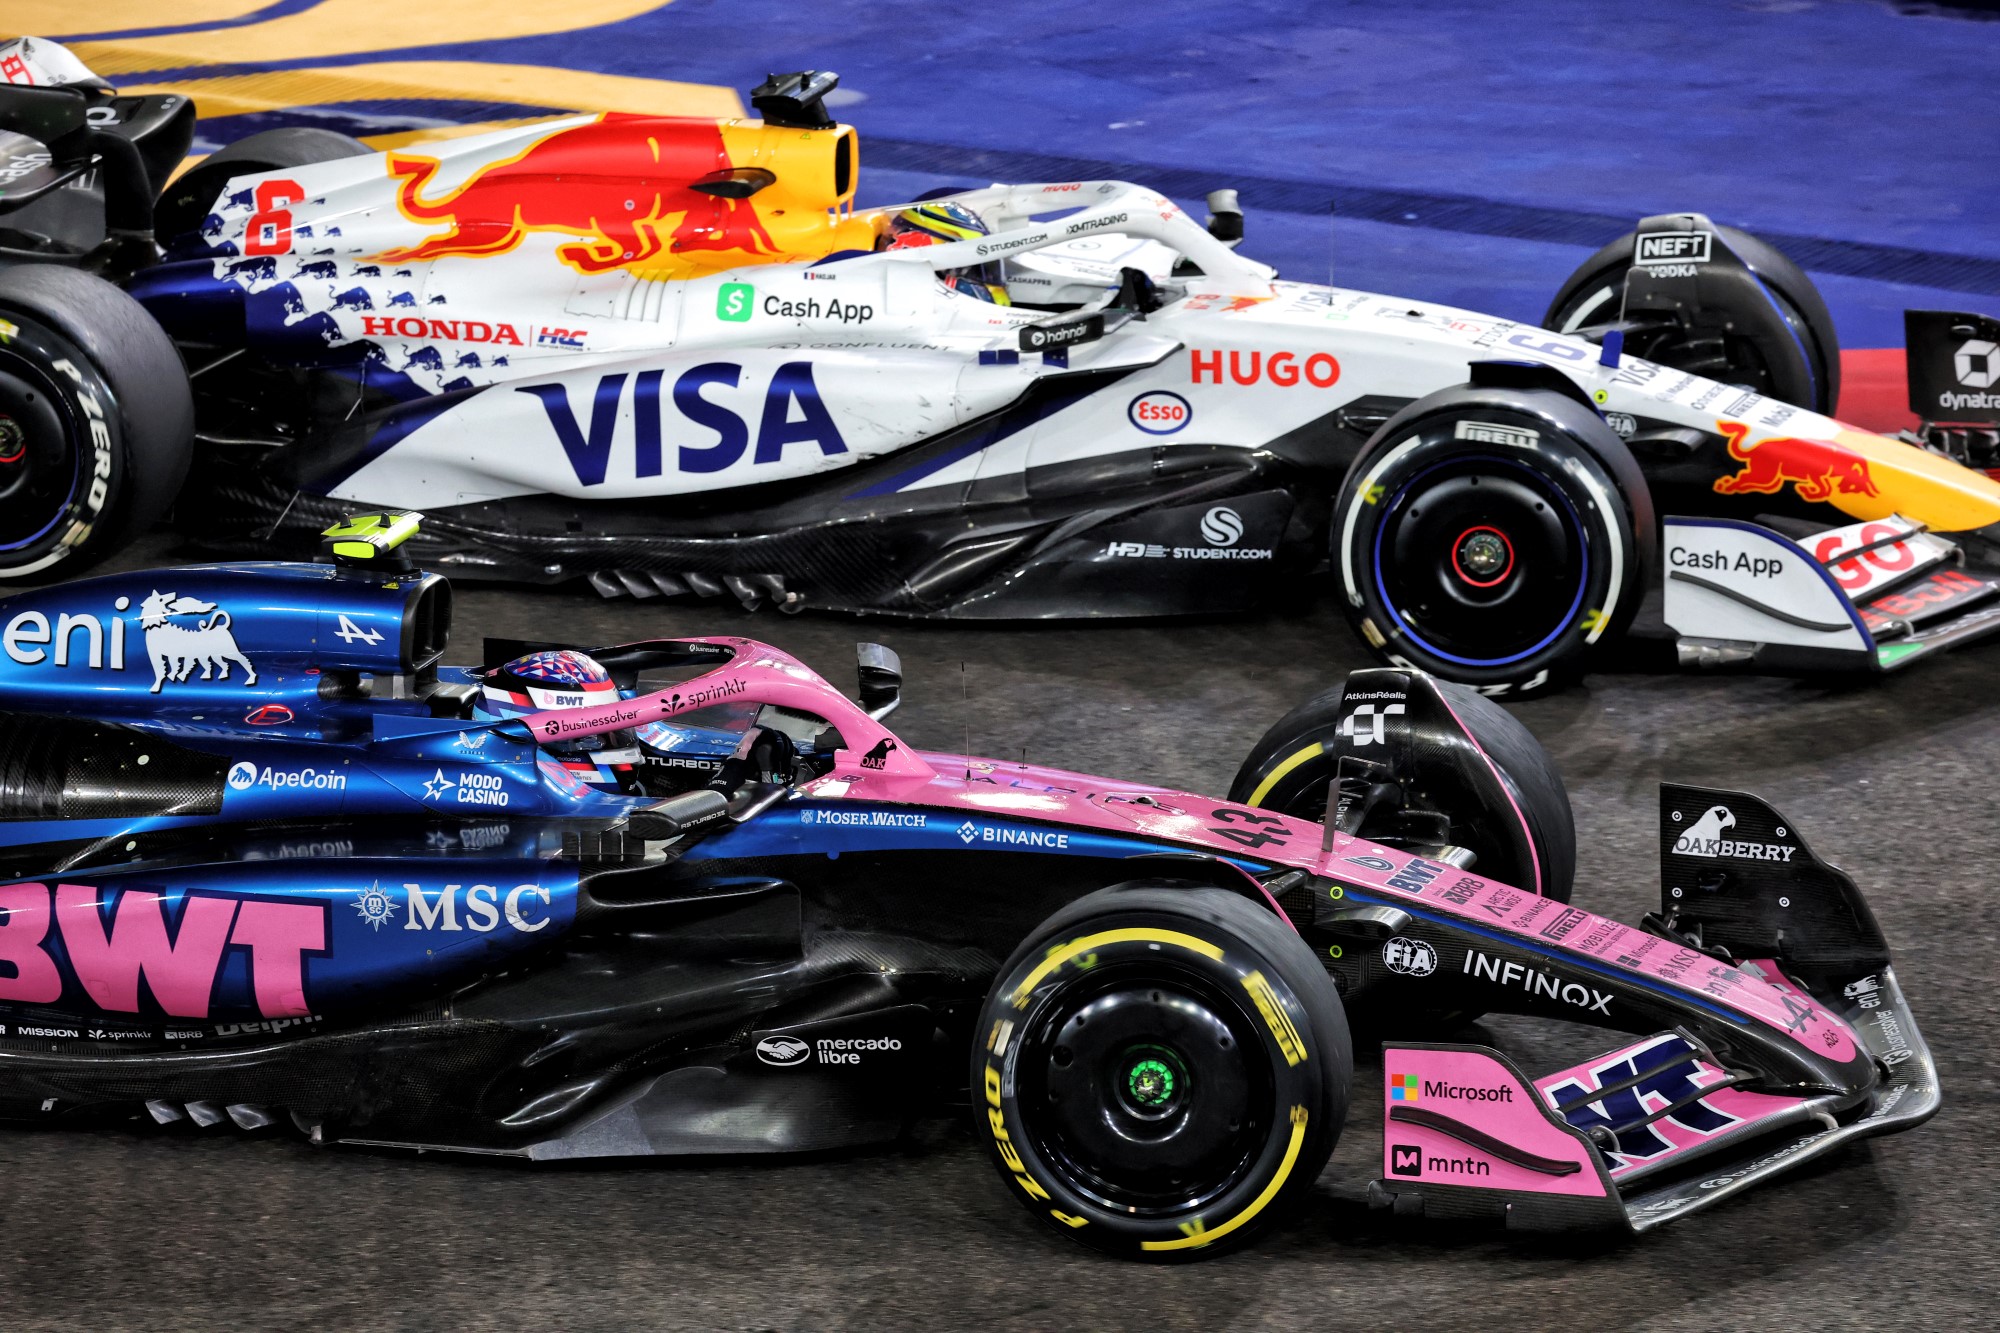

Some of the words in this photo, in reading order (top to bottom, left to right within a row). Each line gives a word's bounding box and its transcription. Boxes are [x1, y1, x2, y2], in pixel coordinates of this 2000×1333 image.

[1042, 183, 1082, 193] HUGO
[990, 233, 1048, 252] STUDENT.COM
[1643, 236, 1703, 257] NEFT
[1648, 264, 1698, 278] VODKA
[764, 295, 820, 318] Cash
[825, 299, 873, 324] App
[361, 316, 524, 346] HONDA
[1046, 322, 1088, 343] hahnair
[810, 342, 955, 352] CONFLUENT
[1191, 349, 1341, 389] HUGO
[1138, 401, 1184, 421] Esso
[515, 363, 848, 485] VISA
[1454, 420, 1541, 450] PIRELLI
[1173, 547, 1272, 560] STUDENT.COM
[1670, 546, 1727, 571] Cash
[1733, 551, 1783, 578] App
[2, 596, 130, 670] eni
[556, 695, 584, 707] BWT
[688, 678, 747, 706] sprinklr
[561, 709, 639, 732] businessolver
[258, 766, 346, 791] ApeCoin
[459, 773, 503, 791] MODO
[457, 788, 509, 807] CASINO
[816, 809, 926, 828] MOSER.WATCH
[1210, 807, 1293, 849] 43
[983, 827, 1069, 850] BINANCE
[1675, 836, 1796, 862] OAKBERRY
[1386, 857, 1446, 895] BWT
[403, 883, 551, 932] MSC
[1520, 898, 1553, 922] BINANCE
[1539, 907, 1589, 942] PIRELLI
[0, 882, 326, 1019] BWT
[1665, 947, 1702, 973] MSC
[1463, 949, 1614, 1016] INFINOX
[18, 1027, 79, 1038] MISSION
[108, 1030, 152, 1041] sprinklr
[178, 1031, 203, 1040] BRB
[214, 1014, 323, 1036] Delp
[817, 1037, 902, 1050] mercado
[818, 1051, 861, 1064] libre
[1424, 1080, 1513, 1103] Microsoft
[985, 1063, 1051, 1201] ZERO
[1428, 1156, 1490, 1176] mntn
